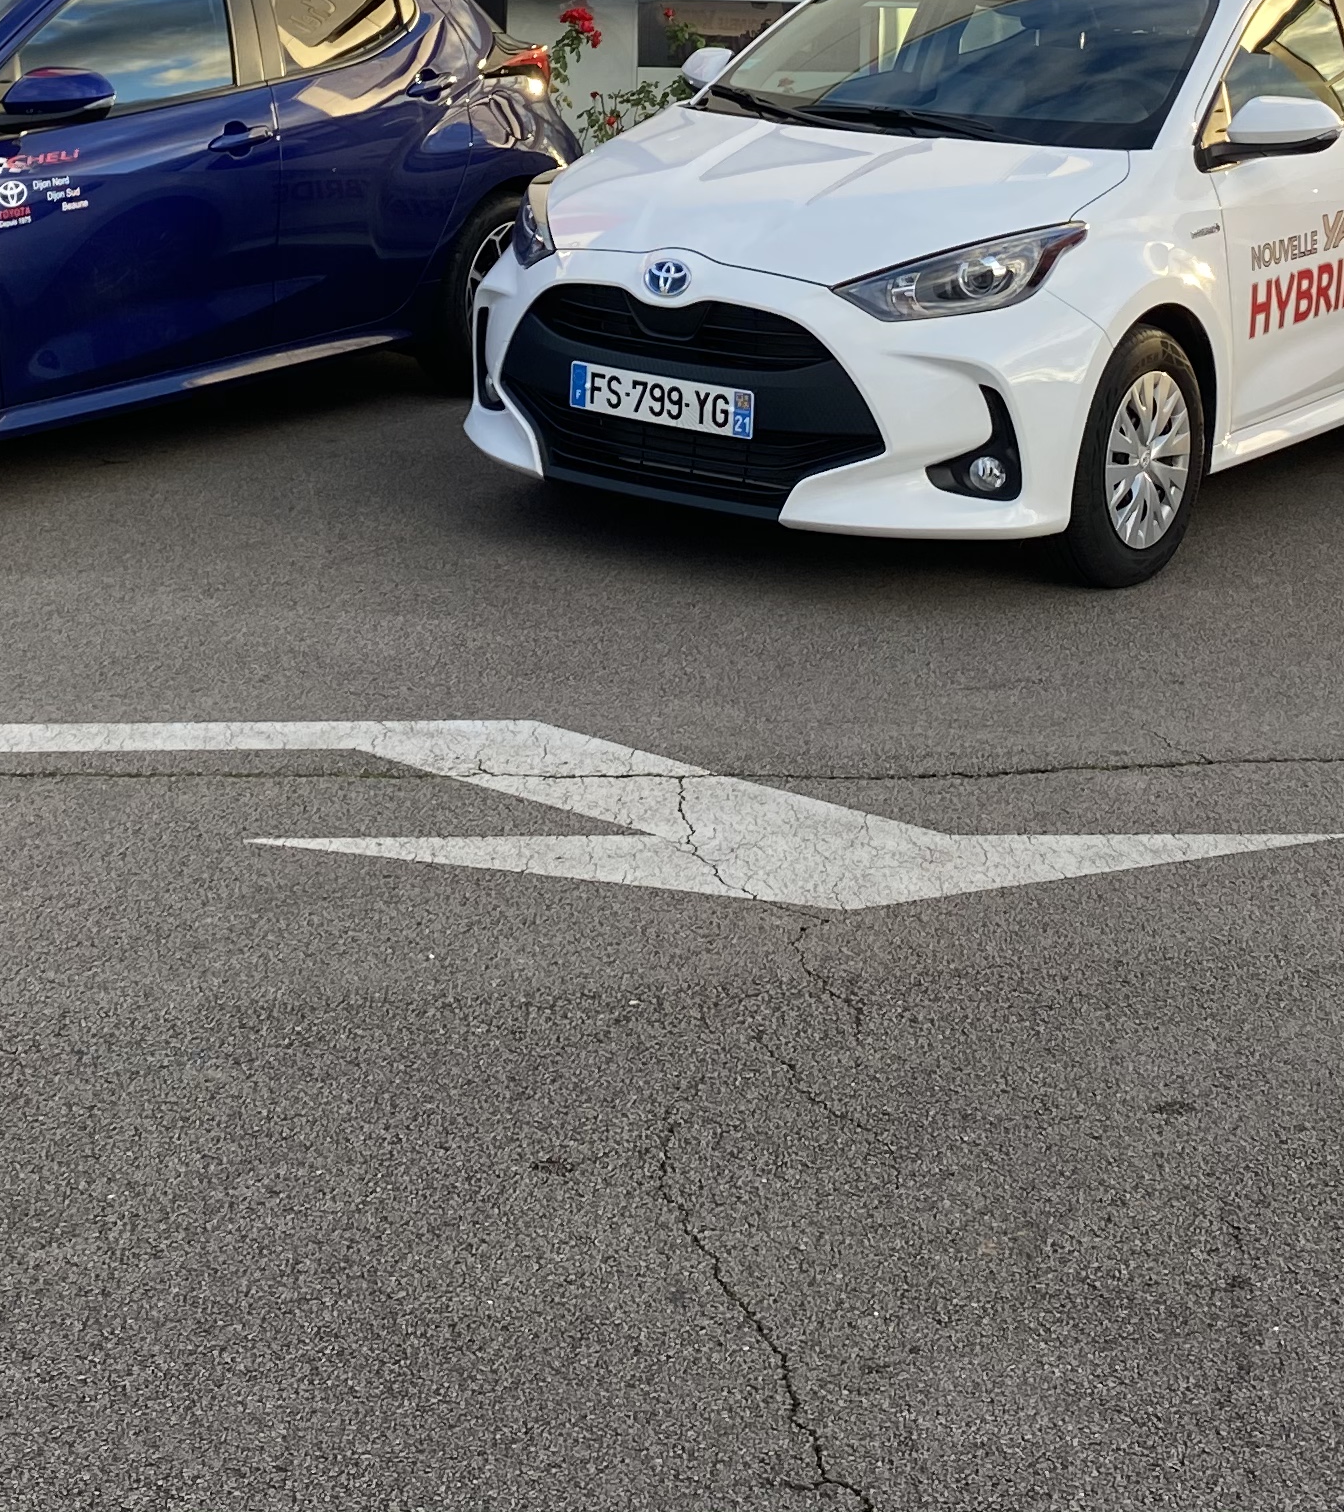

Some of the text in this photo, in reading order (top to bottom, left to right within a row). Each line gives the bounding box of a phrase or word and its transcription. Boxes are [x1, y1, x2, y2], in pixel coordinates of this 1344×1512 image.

[66, 187, 80, 197] Sud
[1251, 230, 1318, 272] NOUVELLE
[575, 390, 582, 400] F
[589, 372, 730, 428] FS-799-YG
[734, 415, 750, 434] 21
